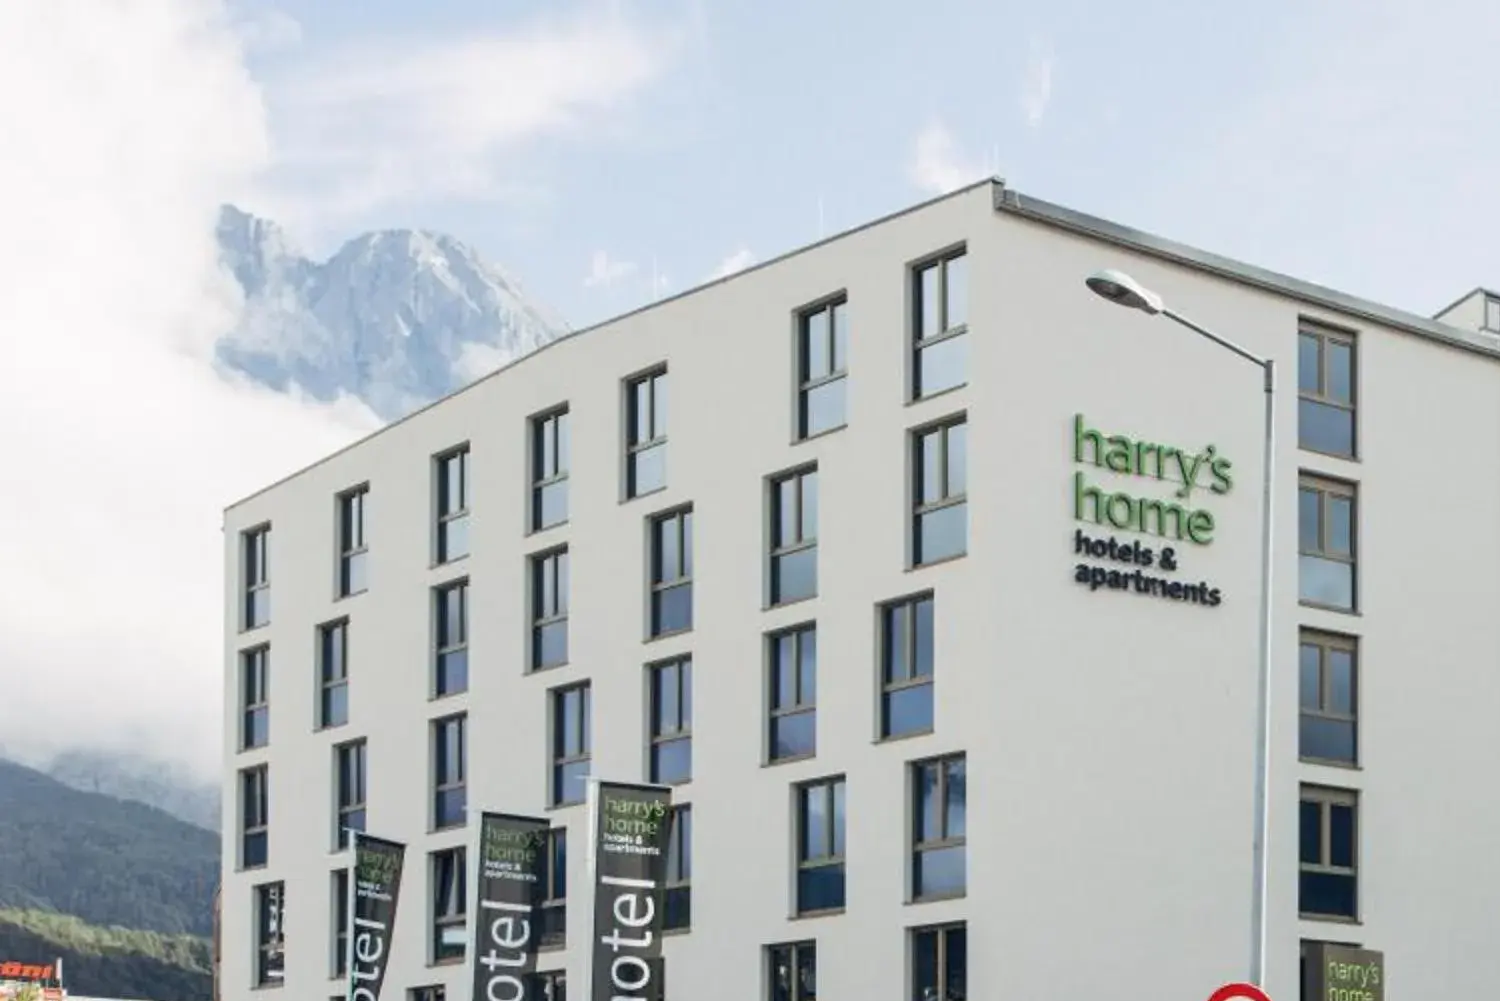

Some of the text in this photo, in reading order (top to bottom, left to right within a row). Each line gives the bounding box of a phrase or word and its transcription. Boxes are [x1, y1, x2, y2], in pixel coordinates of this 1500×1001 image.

[1074, 413, 1234, 497] harry's
[1074, 472, 1216, 545] home
[1074, 529, 1177, 571] hotels &
[1074, 563, 1222, 606] apartments
